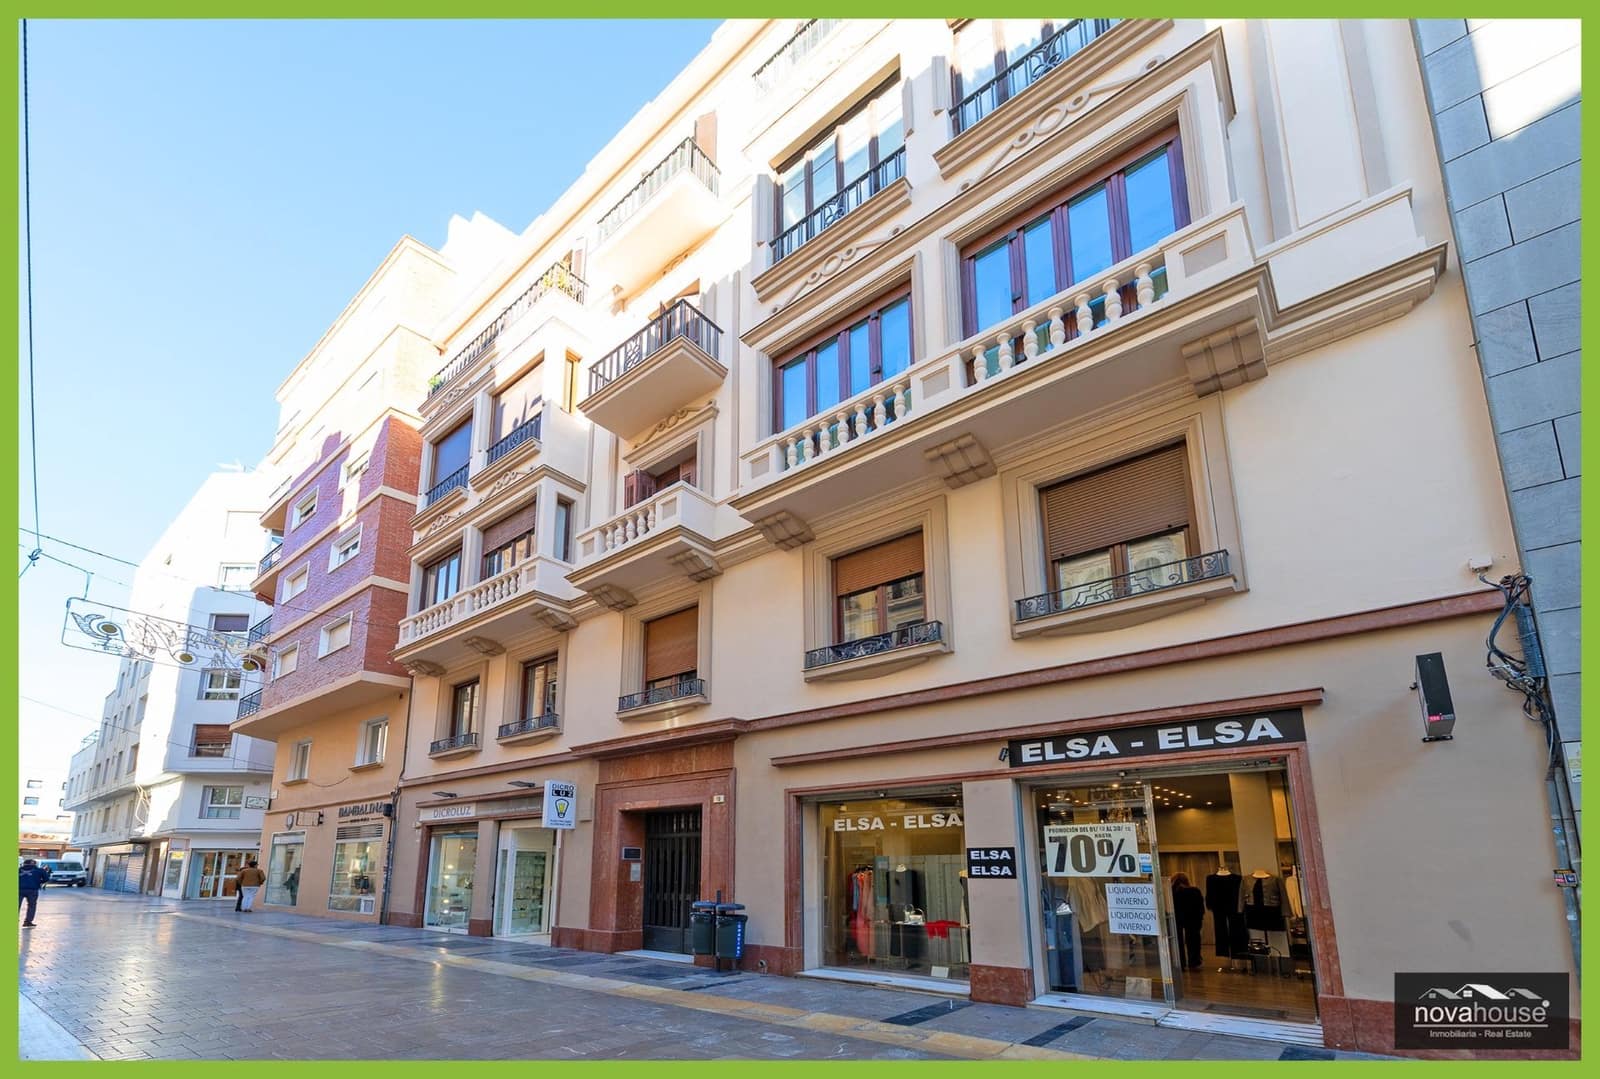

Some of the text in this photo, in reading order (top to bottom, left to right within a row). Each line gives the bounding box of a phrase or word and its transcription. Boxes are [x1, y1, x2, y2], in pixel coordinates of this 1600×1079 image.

[1021, 718, 1283, 763] ELSA - ELSA
[552, 783, 574, 791] DICRO
[552, 790, 573, 798] LUZ
[433, 805, 471, 818] DICROLUZ
[833, 816, 884, 832] ELSA
[904, 813, 964, 829] ELSA
[1048, 826, 1079, 834] PROMOCIÓN
[1080, 825, 1089, 833] DEL
[970, 850, 1011, 860] ELSA
[1048, 834, 1136, 874] 70%
[971, 866, 1012, 876] ELSA
[1108, 886, 1154, 895] LIQUIDACIÓN
[1116, 897, 1149, 905] INVIERNO
[1111, 911, 1156, 920] LIQUIDACIÓN
[1119, 922, 1151, 931] INVIERNO
